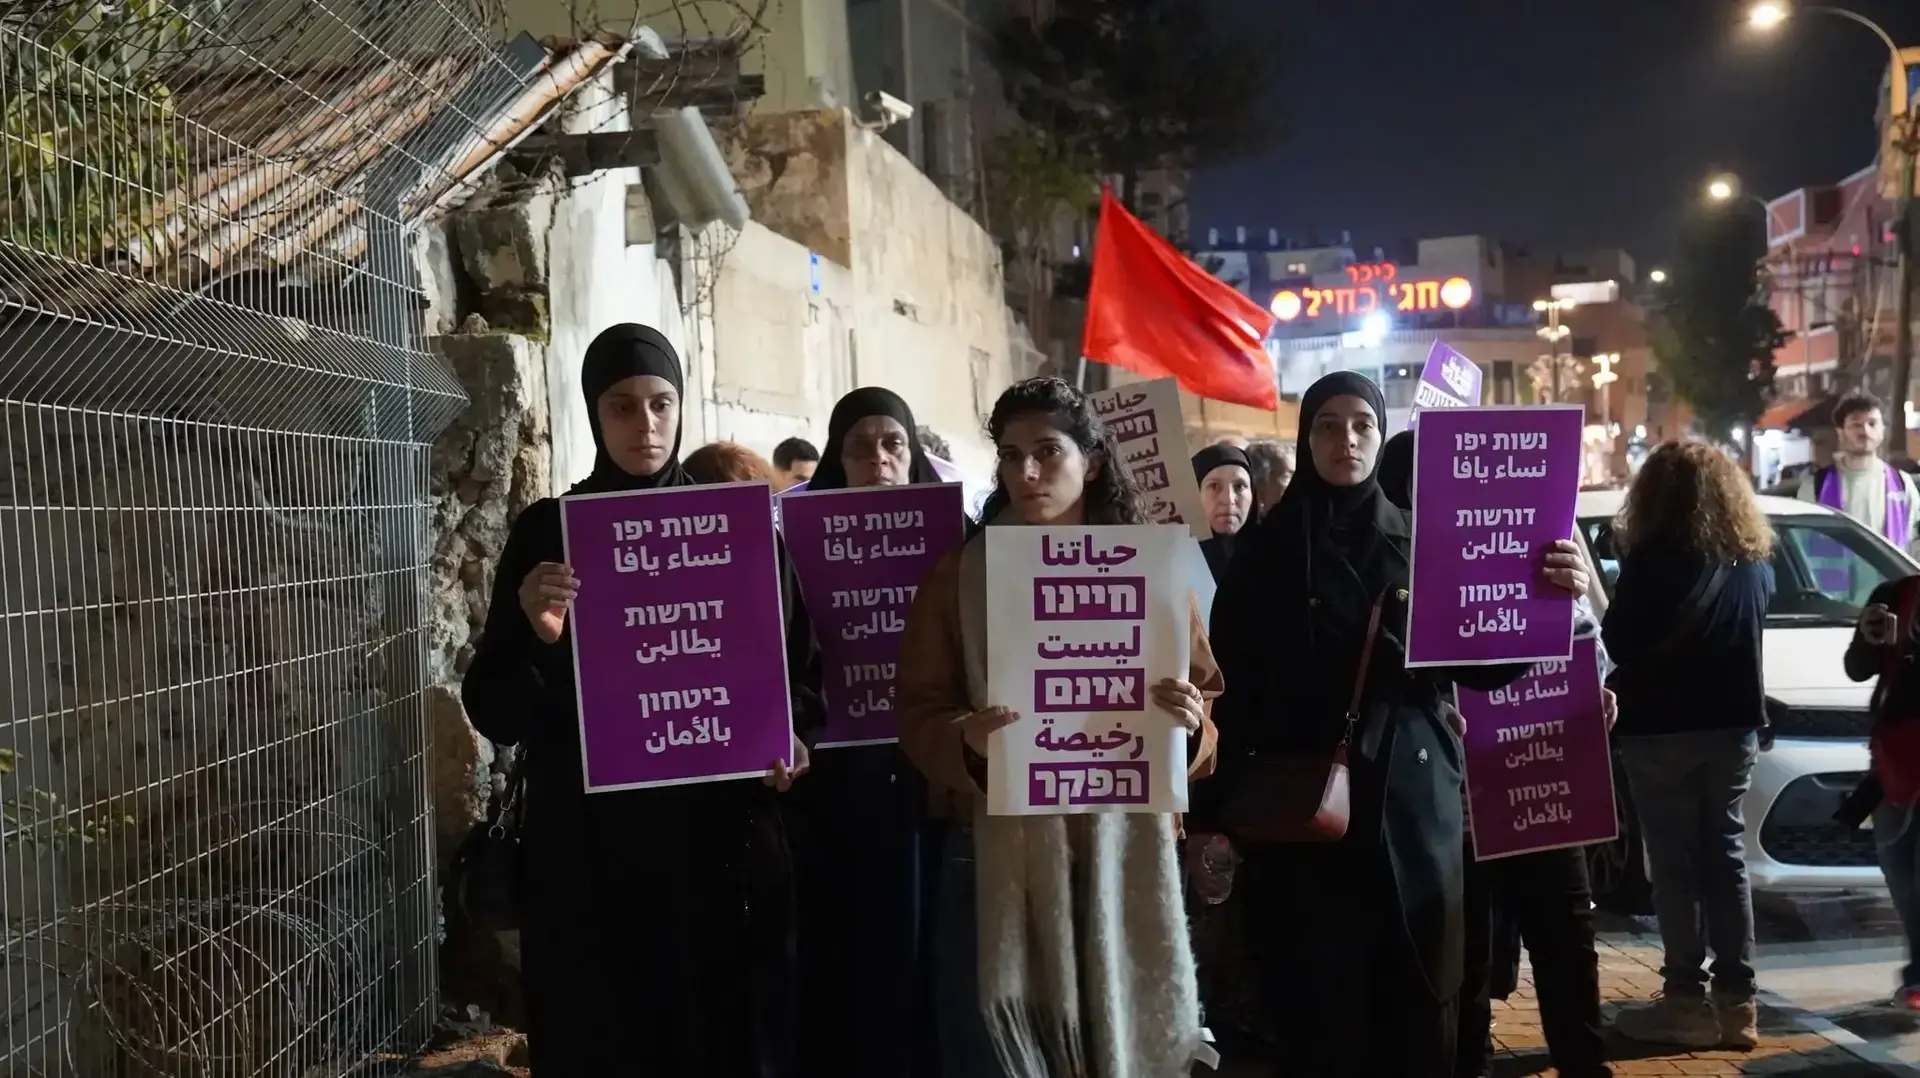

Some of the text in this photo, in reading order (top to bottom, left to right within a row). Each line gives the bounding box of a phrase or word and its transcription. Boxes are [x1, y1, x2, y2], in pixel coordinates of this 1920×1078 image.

[1115, 415, 1152, 434] חיי
[1126, 437, 1159, 463] ليس
[1455, 432, 1548, 451] נשות יפו
[1453, 455, 1547, 484] نساء يافا
[613, 514, 729, 541] נשות יפו
[822, 510, 924, 534] נשות יפו
[1456, 508, 1536, 527] דורשות
[613, 542, 732, 577] نساء يافا
[823, 535, 926, 564] نساء يافا
[1041, 534, 1137, 573] حياتنا
[1461, 532, 1529, 560] يطالبن
[832, 585, 918, 608] דורשות
[1041, 584, 1137, 613] חיינו
[1459, 582, 1528, 608] ביטחון
[624, 600, 724, 627] דורשות
[841, 610, 906, 640] طالبن
[1458, 607, 1527, 638] بالأمان
[635, 628, 721, 664] يطالبن
[1037, 625, 1141, 664] ليست
[843, 662, 896, 687] טחון
[638, 685, 730, 718] ביטחון
[1045, 676, 1137, 705] אינם
[1525, 680, 1569, 701] نساء
[645, 716, 731, 754] بالأمان
[1034, 718, 1144, 760] رخيصة
[1496, 719, 1565, 743] דורשות
[1505, 741, 1564, 769] يطالبن
[1034, 768, 1143, 805] הפקר
[1507, 780, 1571, 807] ביטחון
[1513, 802, 1573, 831] بالأمان
